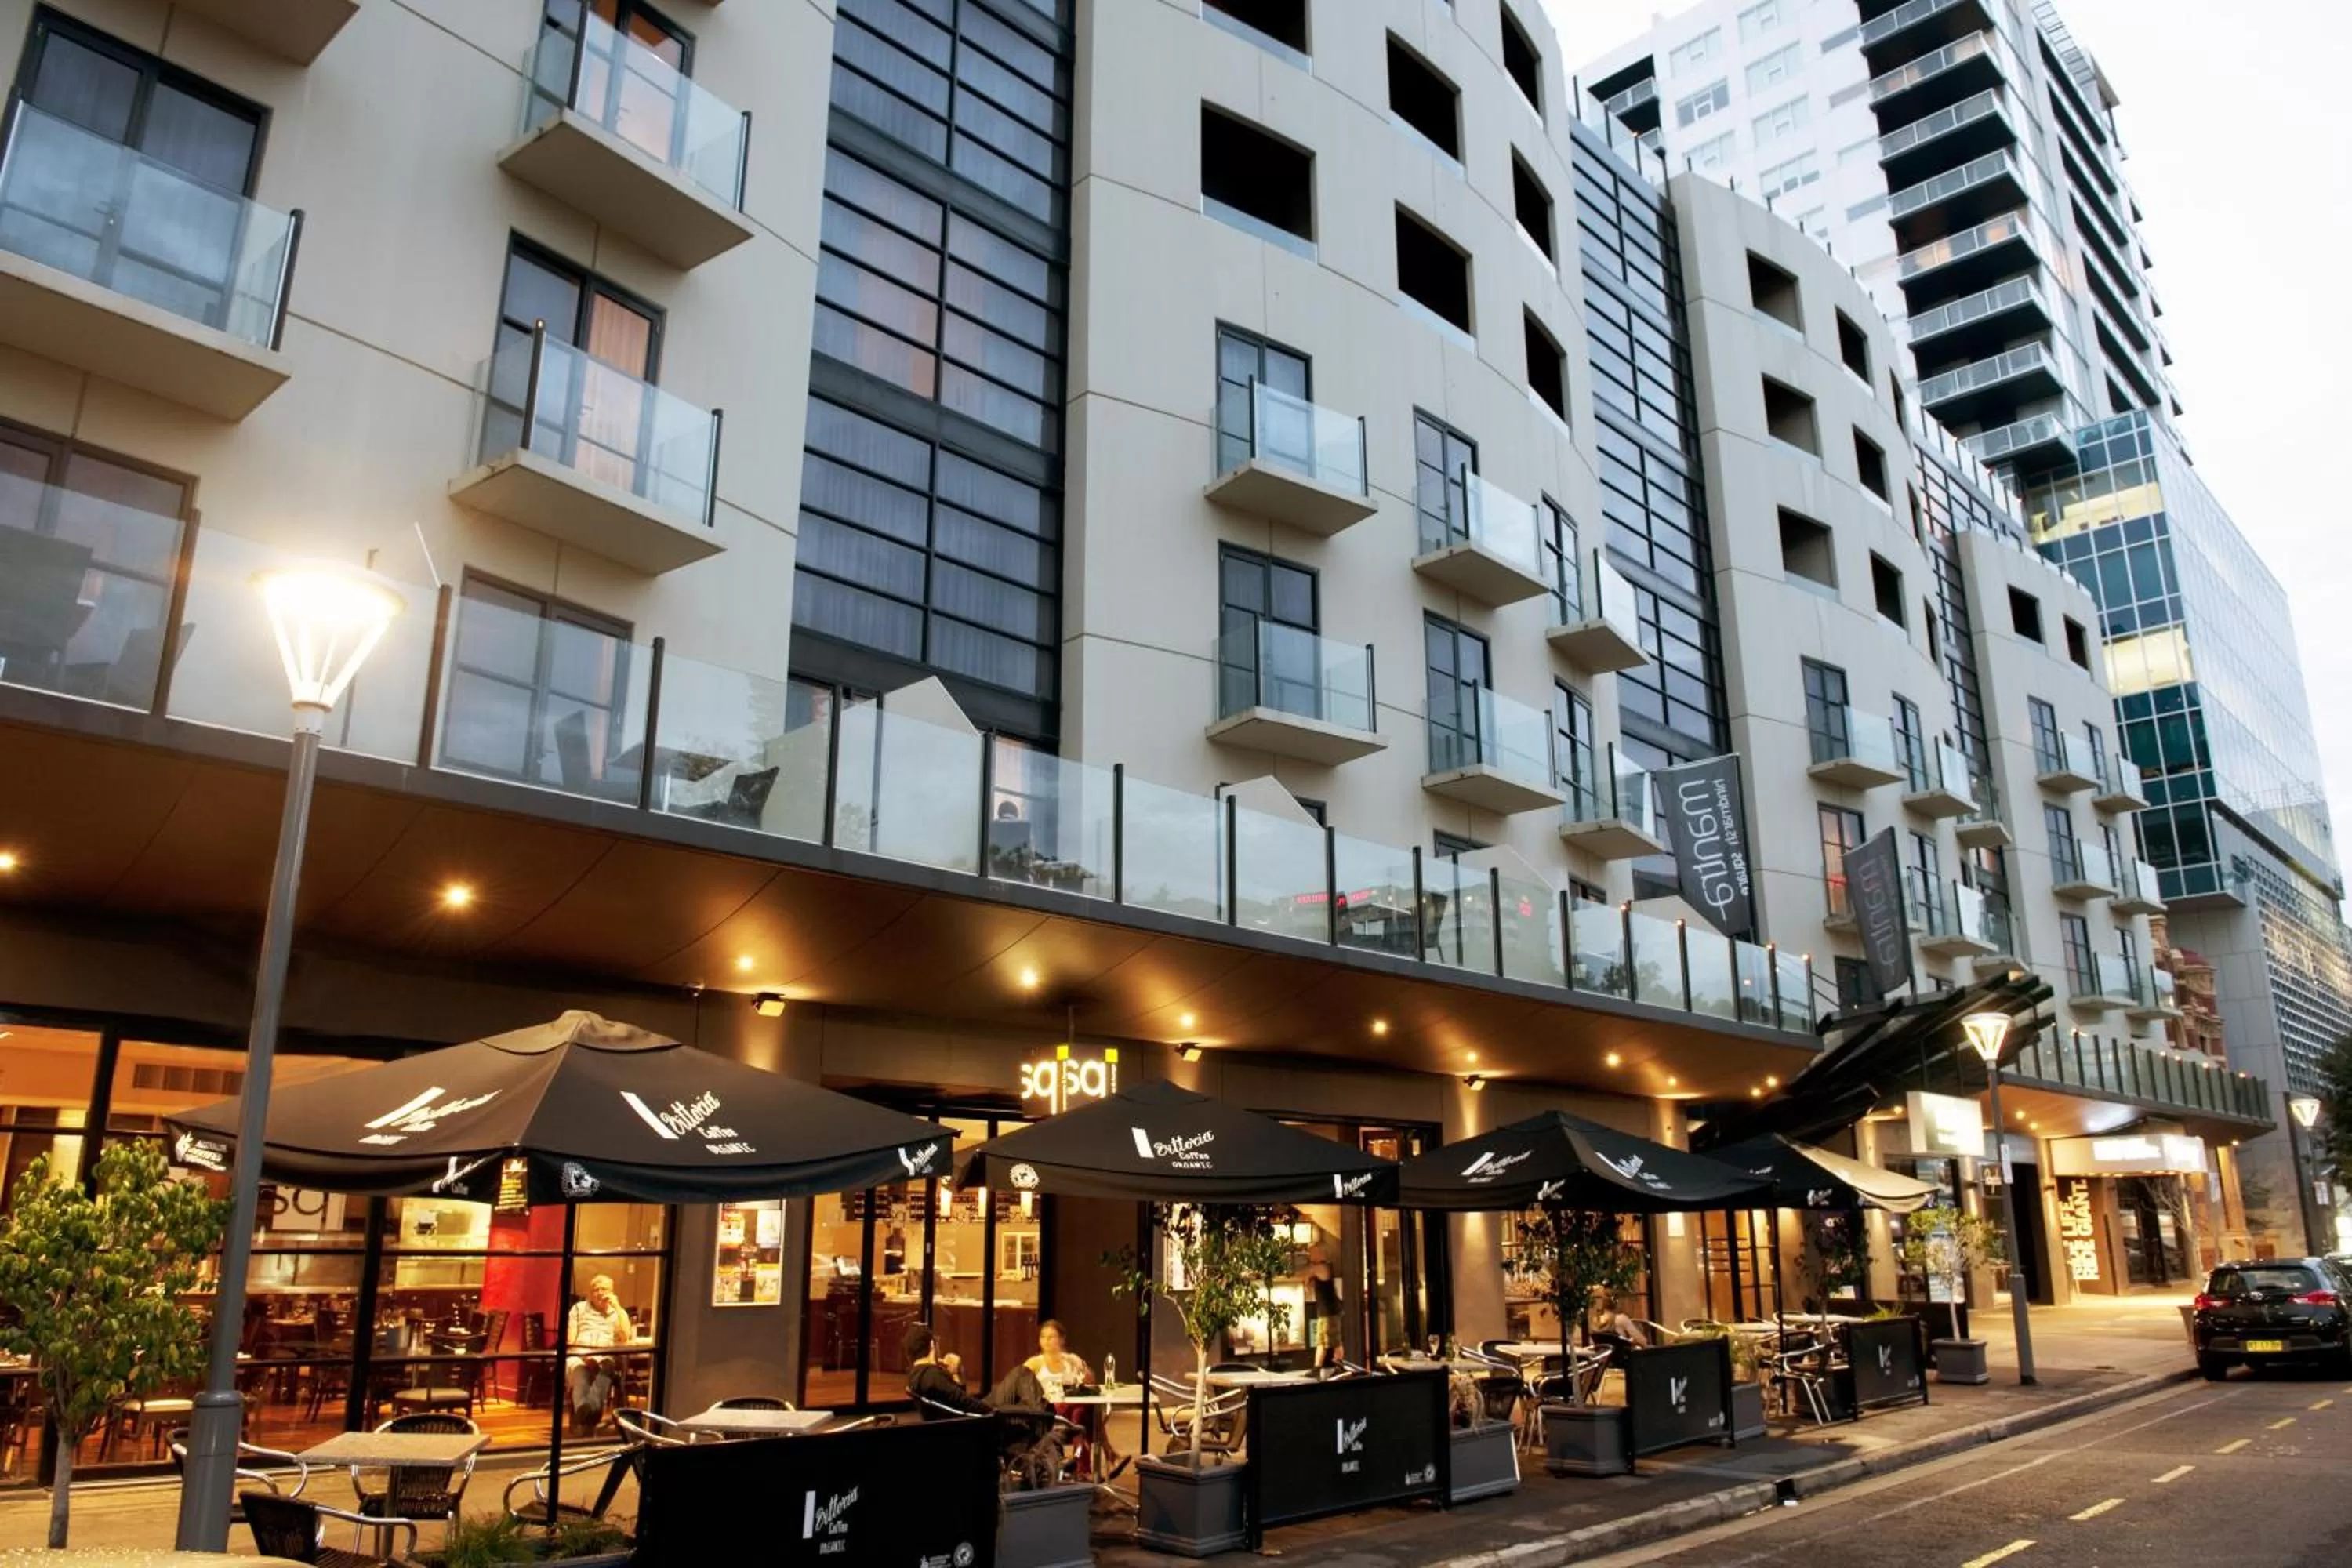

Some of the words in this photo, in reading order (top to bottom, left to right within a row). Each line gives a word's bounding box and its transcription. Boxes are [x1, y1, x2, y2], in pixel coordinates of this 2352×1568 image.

[1131, 1127, 1215, 1158] Vittoria
[2058, 1196, 2078, 1236] LIFE.
[2071, 1178, 2093, 1236] GIANT.
[803, 1486, 859, 1540] Vittoria
